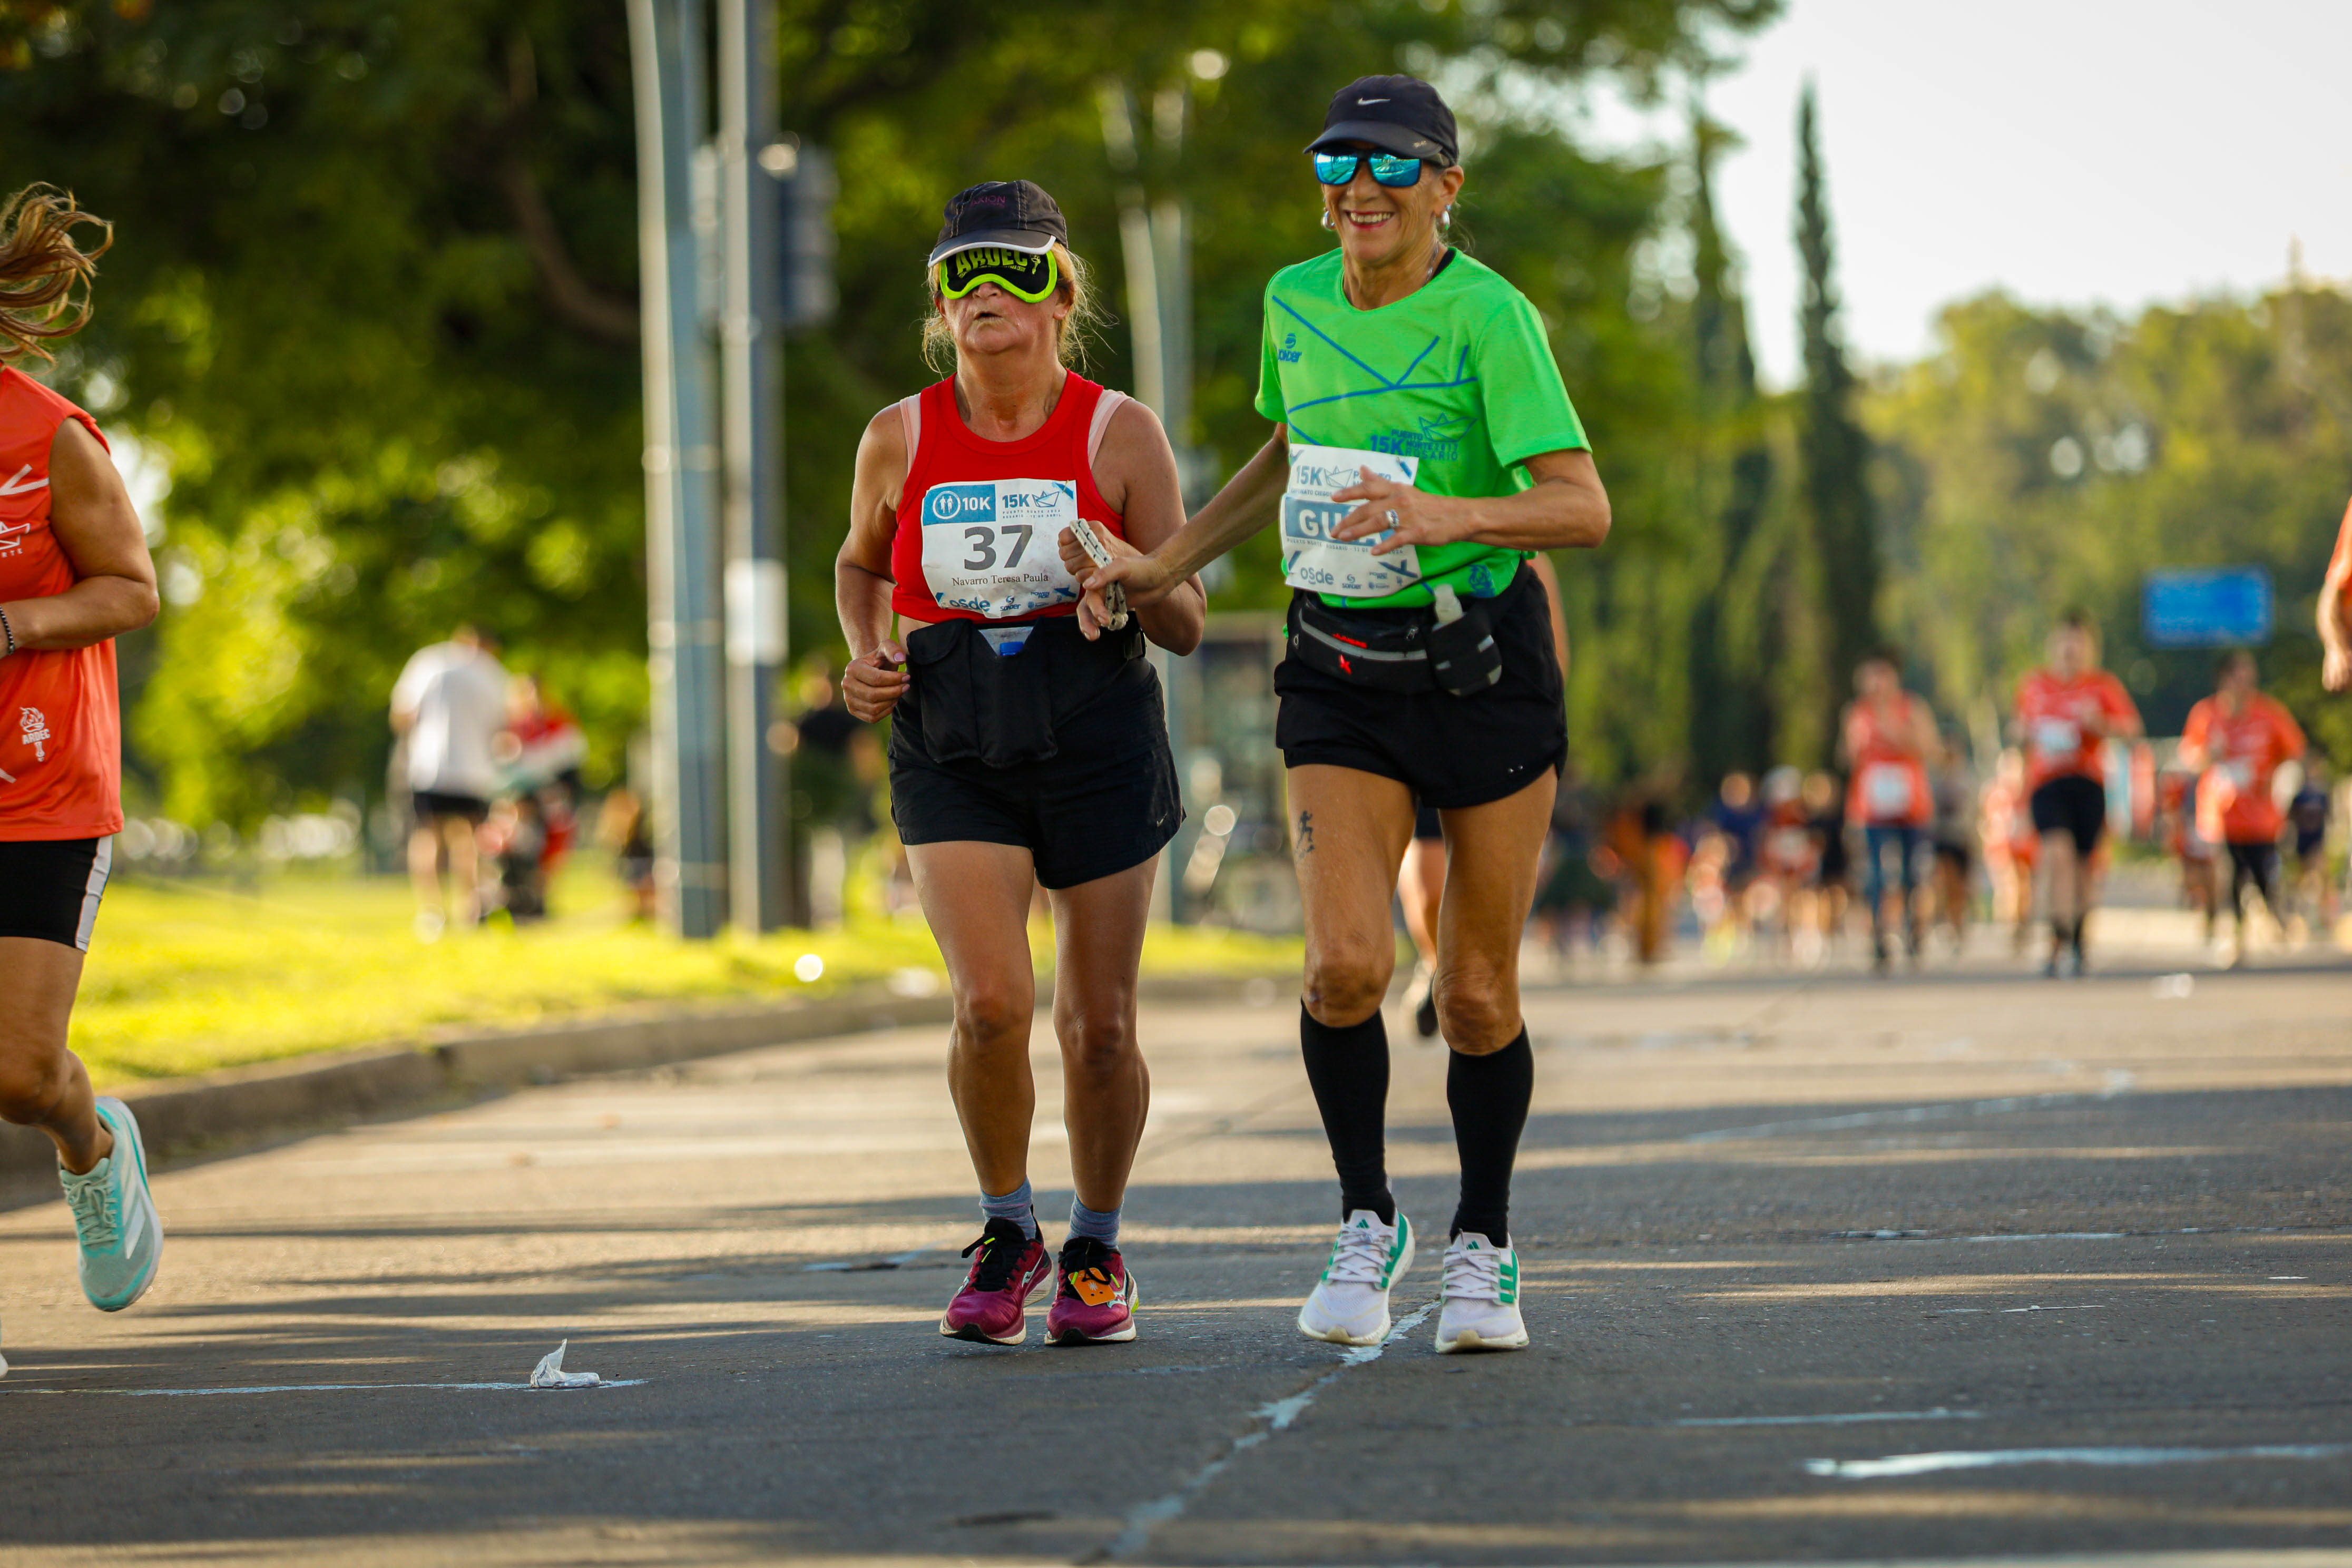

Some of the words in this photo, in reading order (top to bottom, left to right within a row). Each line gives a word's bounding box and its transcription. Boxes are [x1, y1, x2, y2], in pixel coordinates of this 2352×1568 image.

[1370, 435, 1406, 456] 15K
[1406, 448, 1458, 460] ROSARIO
[1296, 465, 1324, 486] 15K
[1353, 470, 1392, 483] PTO
[962, 496, 991, 511] 10K
[1002, 493, 1030, 508] 15K
[1299, 505, 1383, 544] GU
[964, 524, 1033, 571] 37
[952, 577, 988, 586] Navarro
[991, 575, 1021, 584] Teresa
[1023, 573, 1049, 582] Paula
[1300, 567, 1334, 585] osde
[949, 596, 991, 612] osde
[22, 728, 51, 745] ARDEC
